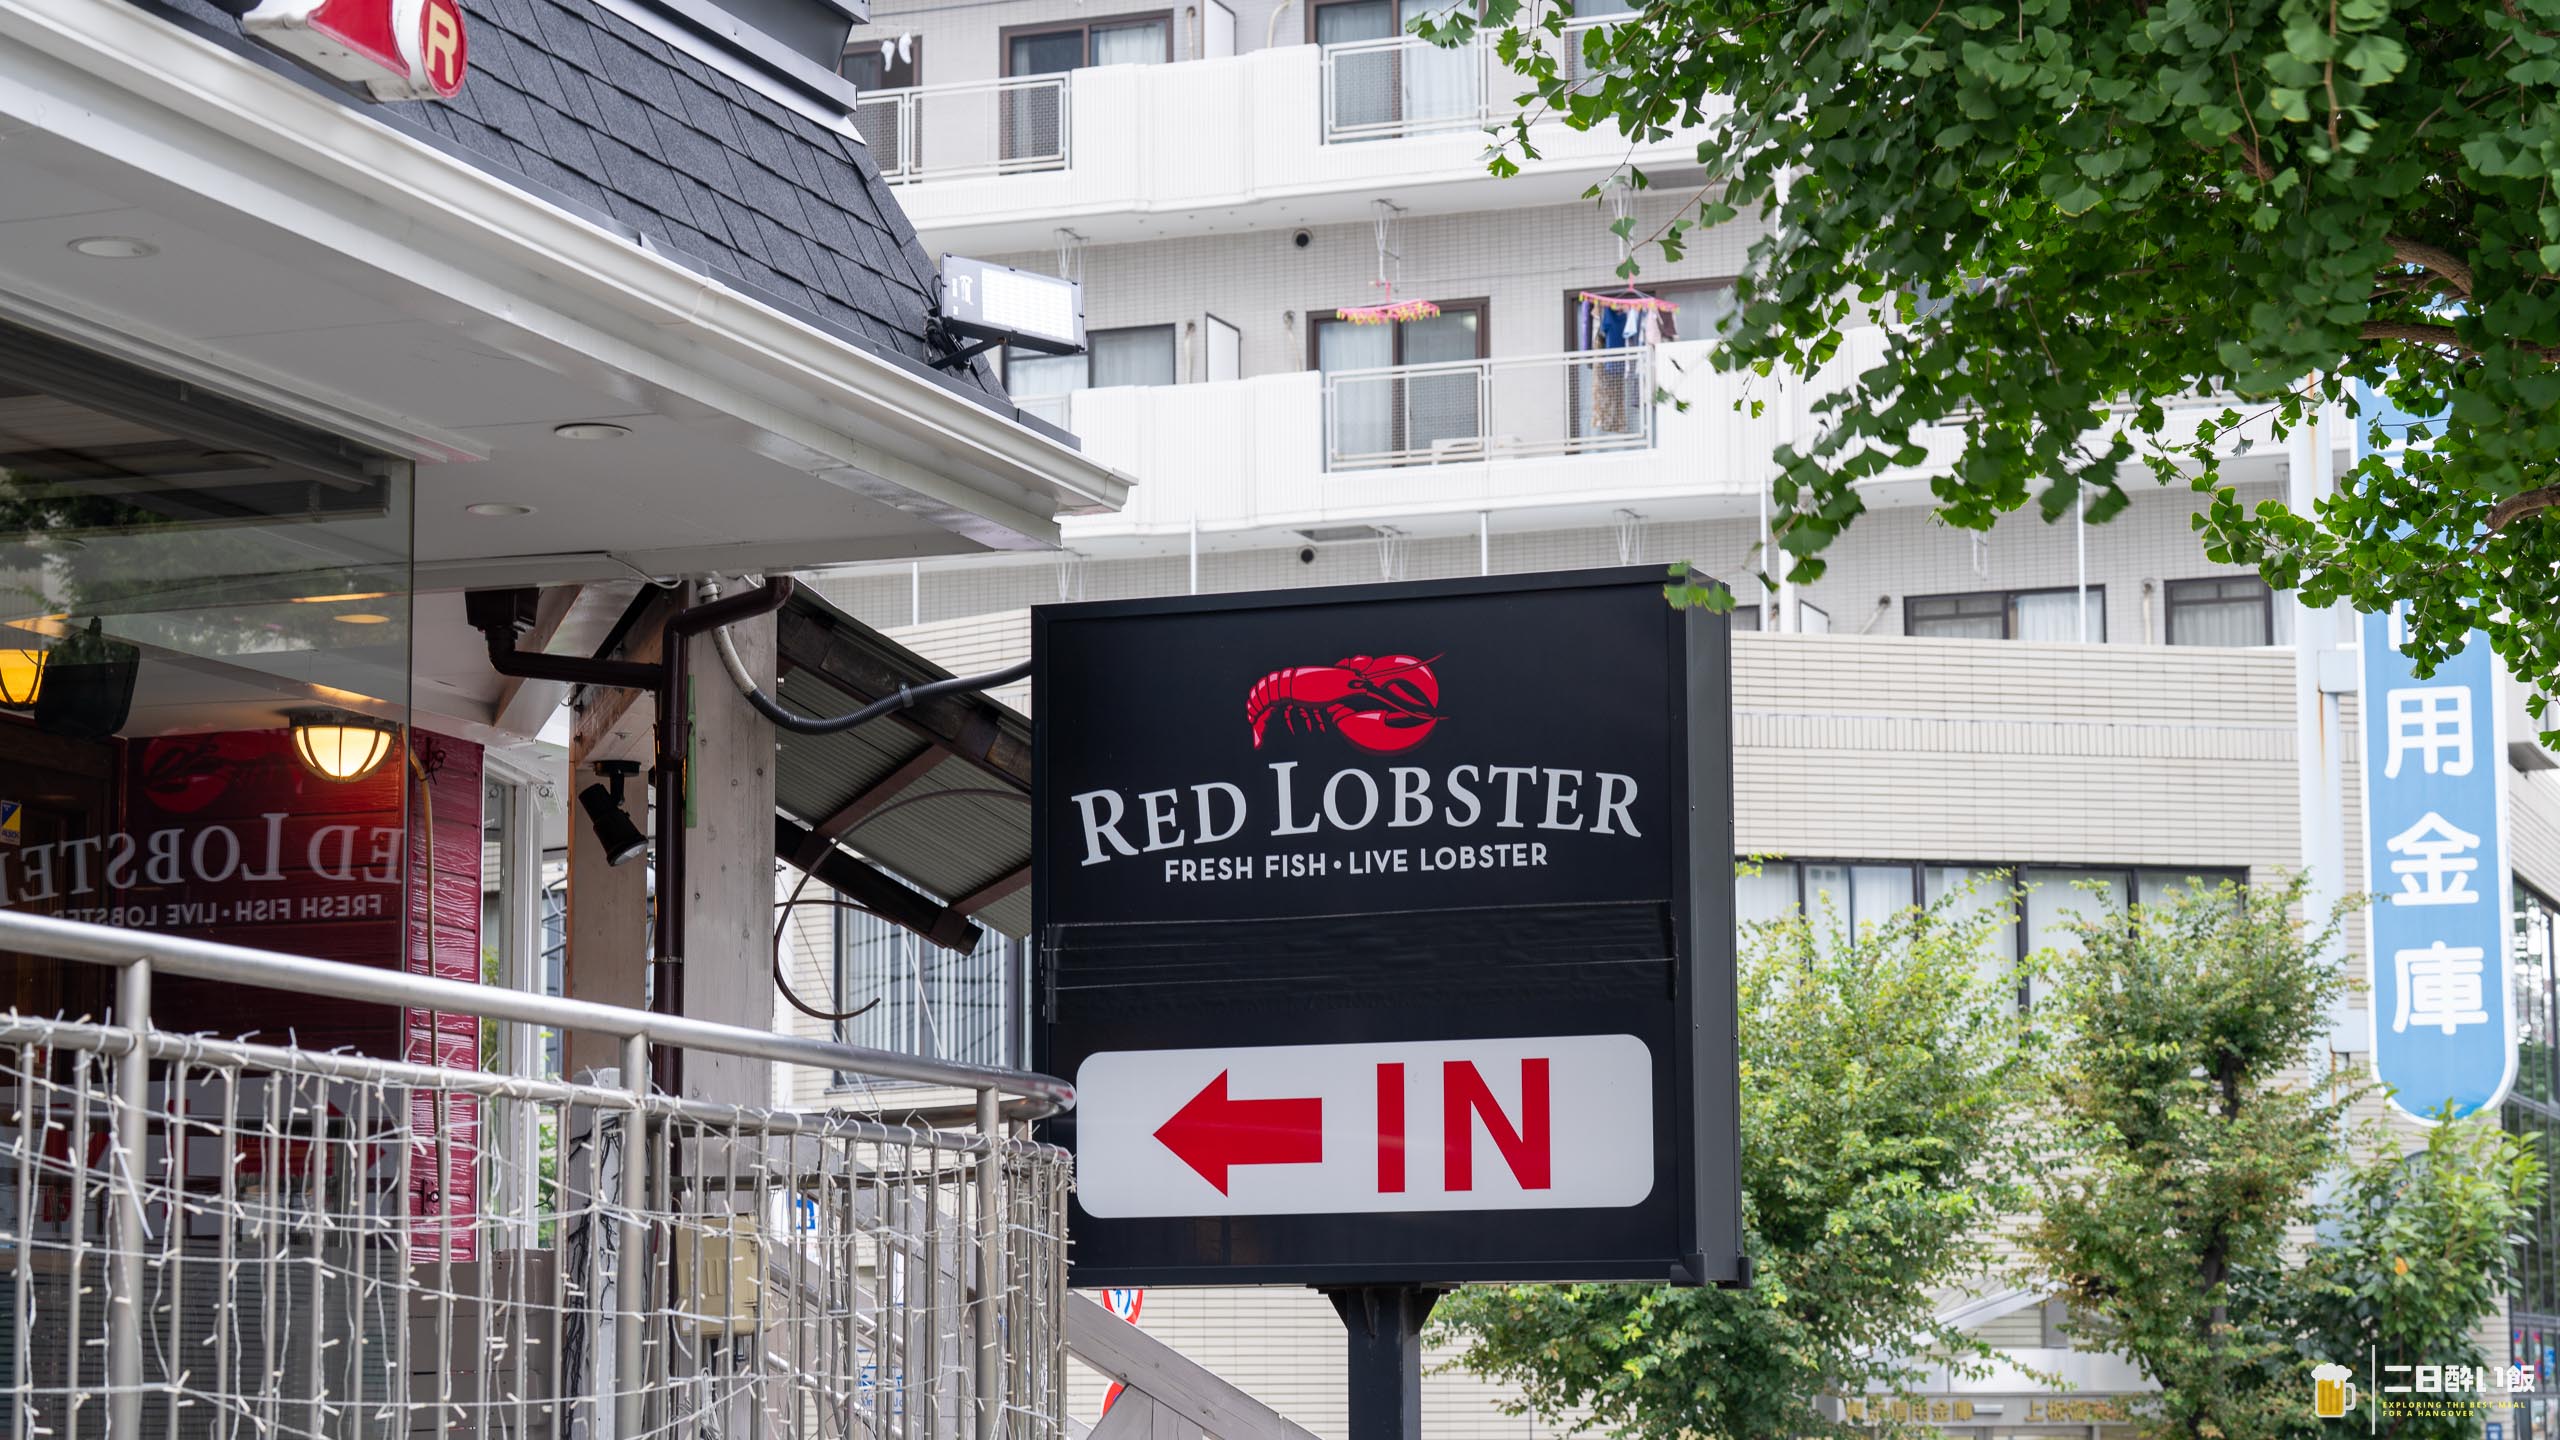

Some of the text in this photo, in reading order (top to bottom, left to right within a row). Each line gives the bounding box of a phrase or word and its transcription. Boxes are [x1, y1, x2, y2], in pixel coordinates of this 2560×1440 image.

[426, 1, 458, 86] R
[1071, 761, 1643, 868] RED LOBSTER
[1165, 856, 1253, 883] FRESH
[1265, 852, 1327, 878] FISH
[1349, 848, 1409, 875] LIVE
[1420, 842, 1548, 871] LOBSTER
[1376, 1057, 1551, 1193] IN
